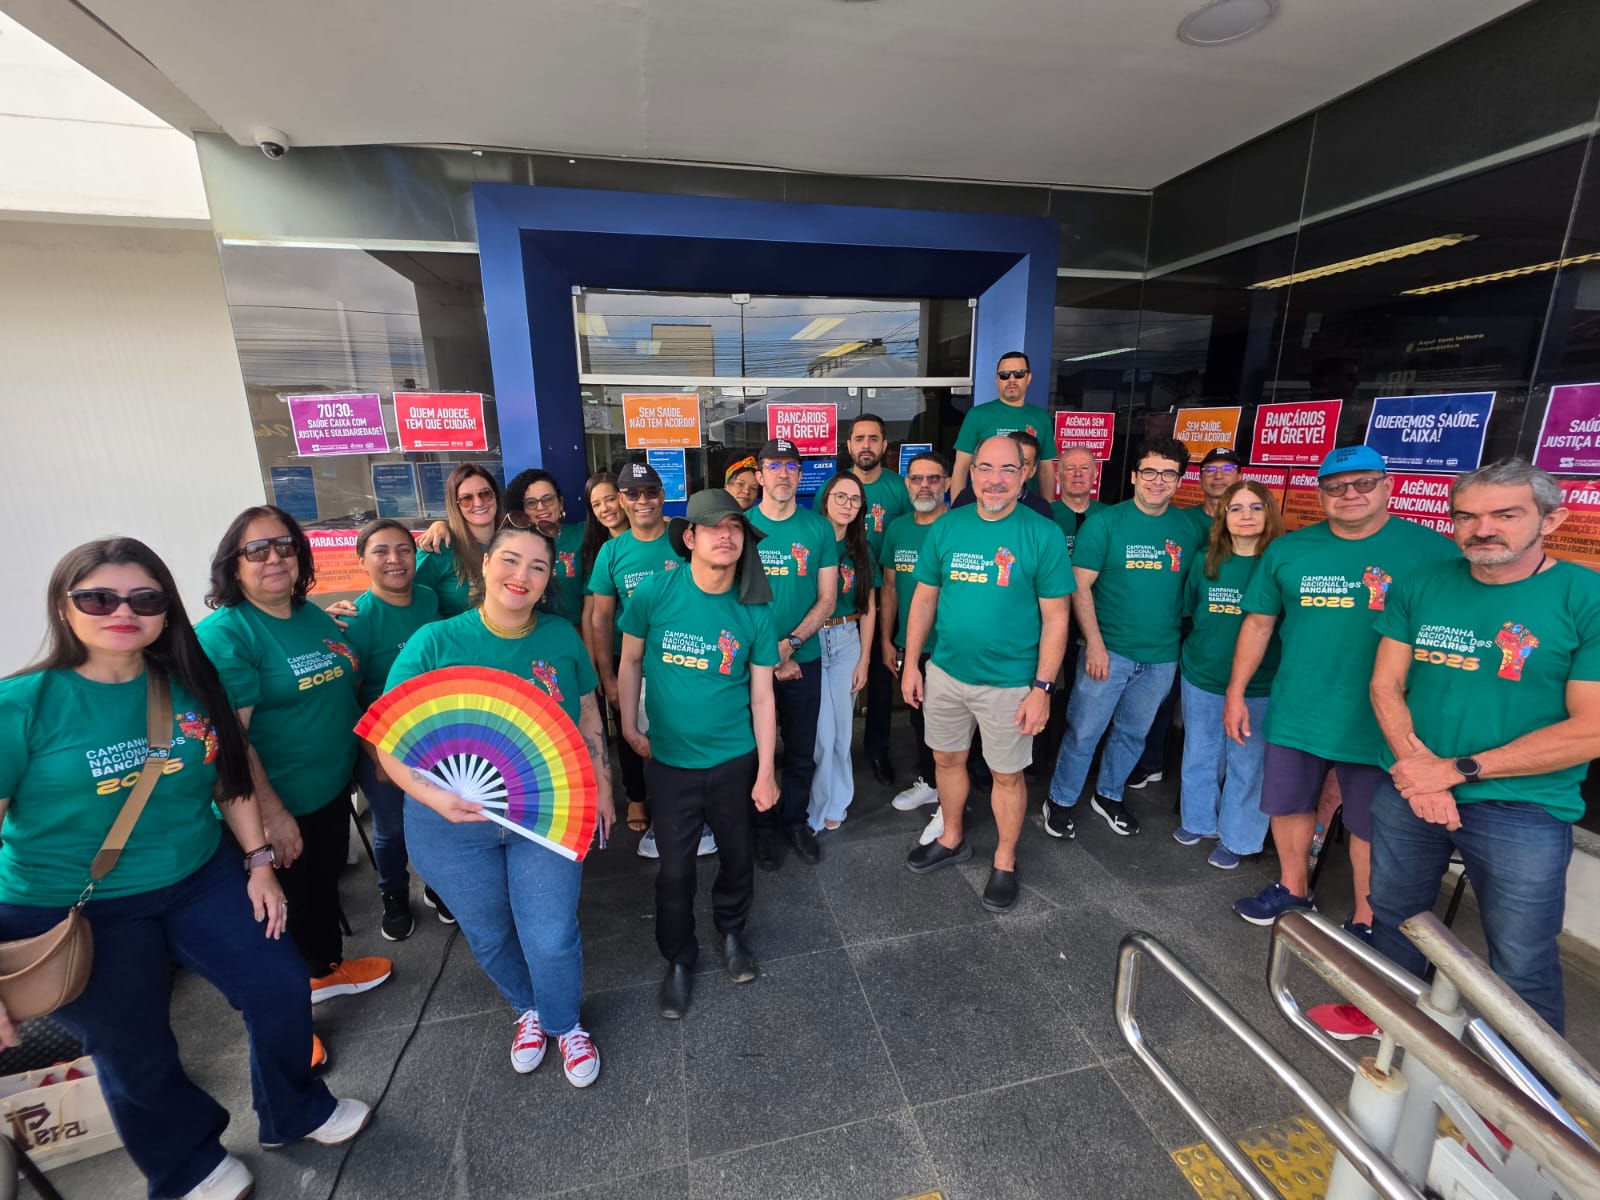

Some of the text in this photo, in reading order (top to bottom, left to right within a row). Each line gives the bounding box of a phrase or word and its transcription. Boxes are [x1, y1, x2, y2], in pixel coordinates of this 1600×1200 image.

[317, 403, 354, 418] 70/30:
[410, 406, 470, 418] QUEM ADOECE
[638, 406, 656, 417] SEM
[778, 410, 826, 424] BANCÁRIOS
[1265, 408, 1326, 426] BANCÁRIOS
[308, 418, 366, 428] SAÚDE CAIXA COM
[404, 418, 476, 430] TEM QUE CUIDAR!
[630, 417, 695, 428] NÃO TEM ACORDO!
[1066, 416, 1104, 426] AGÊNCIA SEM
[1374, 410, 1480, 428] QUEREMOS SAÚDE,
[298, 429, 324, 440] JUSTIÇA
[325, 429, 330, 438] E
[332, 426, 382, 438] SOLIDARIEDADE!
[776, 424, 829, 438] EM GREVE!
[1060, 428, 1108, 438] FUNCIONAMENTO
[1186, 421, 1200, 432] SEM
[1177, 430, 1232, 442] NÃO TEM ACORDO!
[1260, 426, 1326, 444] EM GREVE!
[1402, 428, 1443, 442] CAIXA!
[1542, 436, 1592, 450] JUSTIÇA
[1400, 480, 1449, 498] AGÊNCIA
[1386, 496, 1450, 514] FUNCIONAM
[896, 564, 914, 572] 202
[1126, 560, 1162, 570] 2026
[950, 570, 988, 584] 2026
[1300, 596, 1355, 608] 2026
[1208, 604, 1242, 615] 2026
[664, 630, 704, 642] CAMPANHA
[1417, 631, 1467, 644] NACIONAL
[1420, 624, 1474, 638] CAMPANHA
[663, 636, 700, 649] NACIONAL
[662, 652, 710, 670] 2026
[1414, 648, 1480, 671] 2026
[298, 666, 344, 691] 2026
[86, 736, 148, 760] CAMPANH
[96, 757, 184, 795] 206
